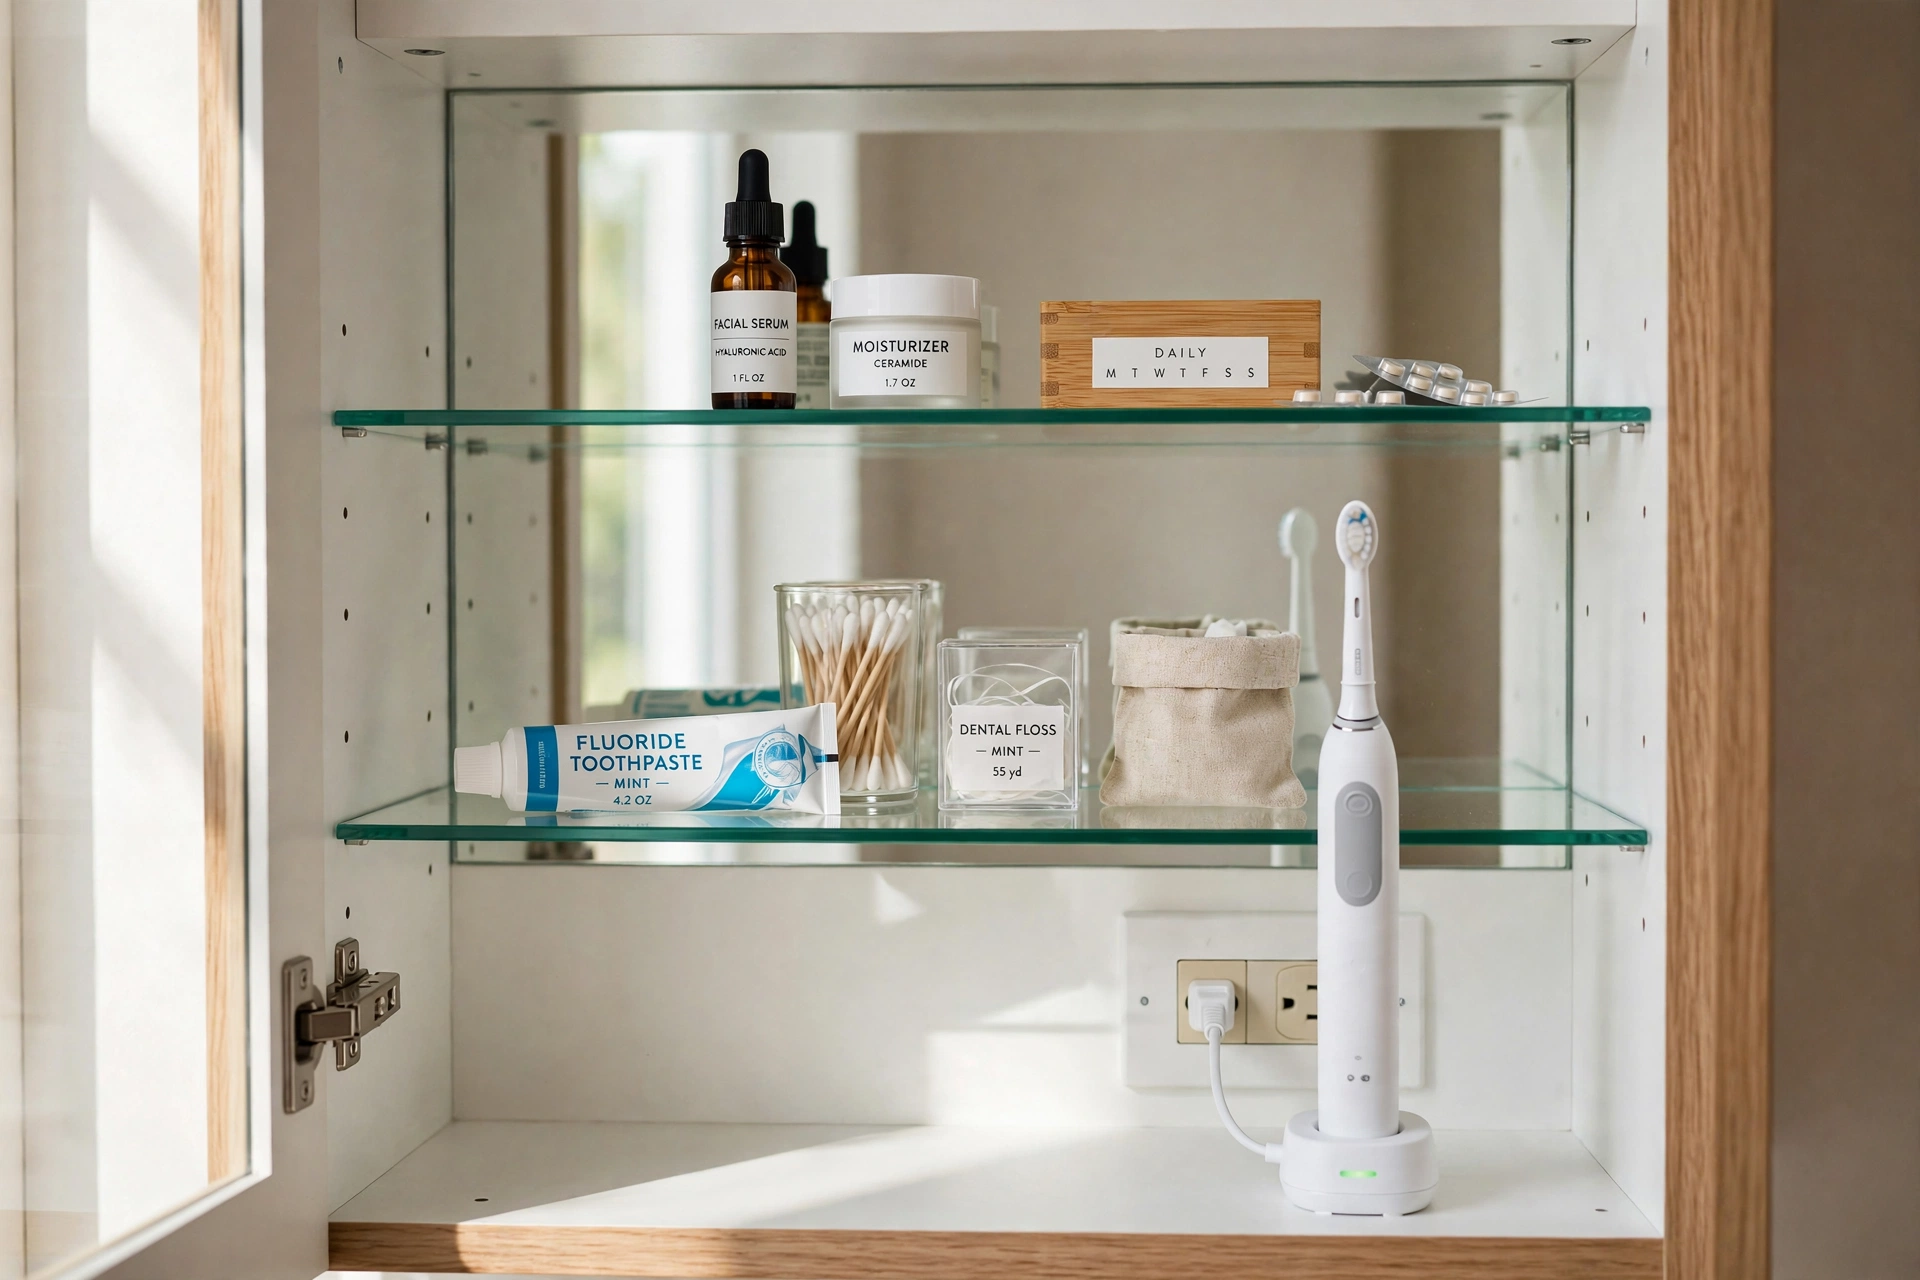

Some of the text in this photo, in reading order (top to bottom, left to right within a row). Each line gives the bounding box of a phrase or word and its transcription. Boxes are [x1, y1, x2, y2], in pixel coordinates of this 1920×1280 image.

[714, 317, 789, 330] FACIAL SERUM
[715, 347, 787, 357] HYALURONIC ACID
[853, 339, 949, 353] MOISTURIZER
[1155, 347, 1207, 359] DAILY
[873, 358, 928, 368] CERAMIDE
[739, 373, 750, 383] FL
[751, 373, 765, 383] OZ
[1106, 367, 1255, 378] M T W T F S S
[885, 377, 916, 388] 1.7 OZ
[960, 723, 1057, 736] DENTAL FLOSS
[576, 733, 686, 751] FLUORIDE
[991, 746, 1024, 757] MINT
[569, 754, 703, 772] TOOTHPASTE
[992, 765, 1022, 781] 55 yd
[614, 777, 650, 789] MINT
[613, 795, 652, 806] 4.2 OZ
